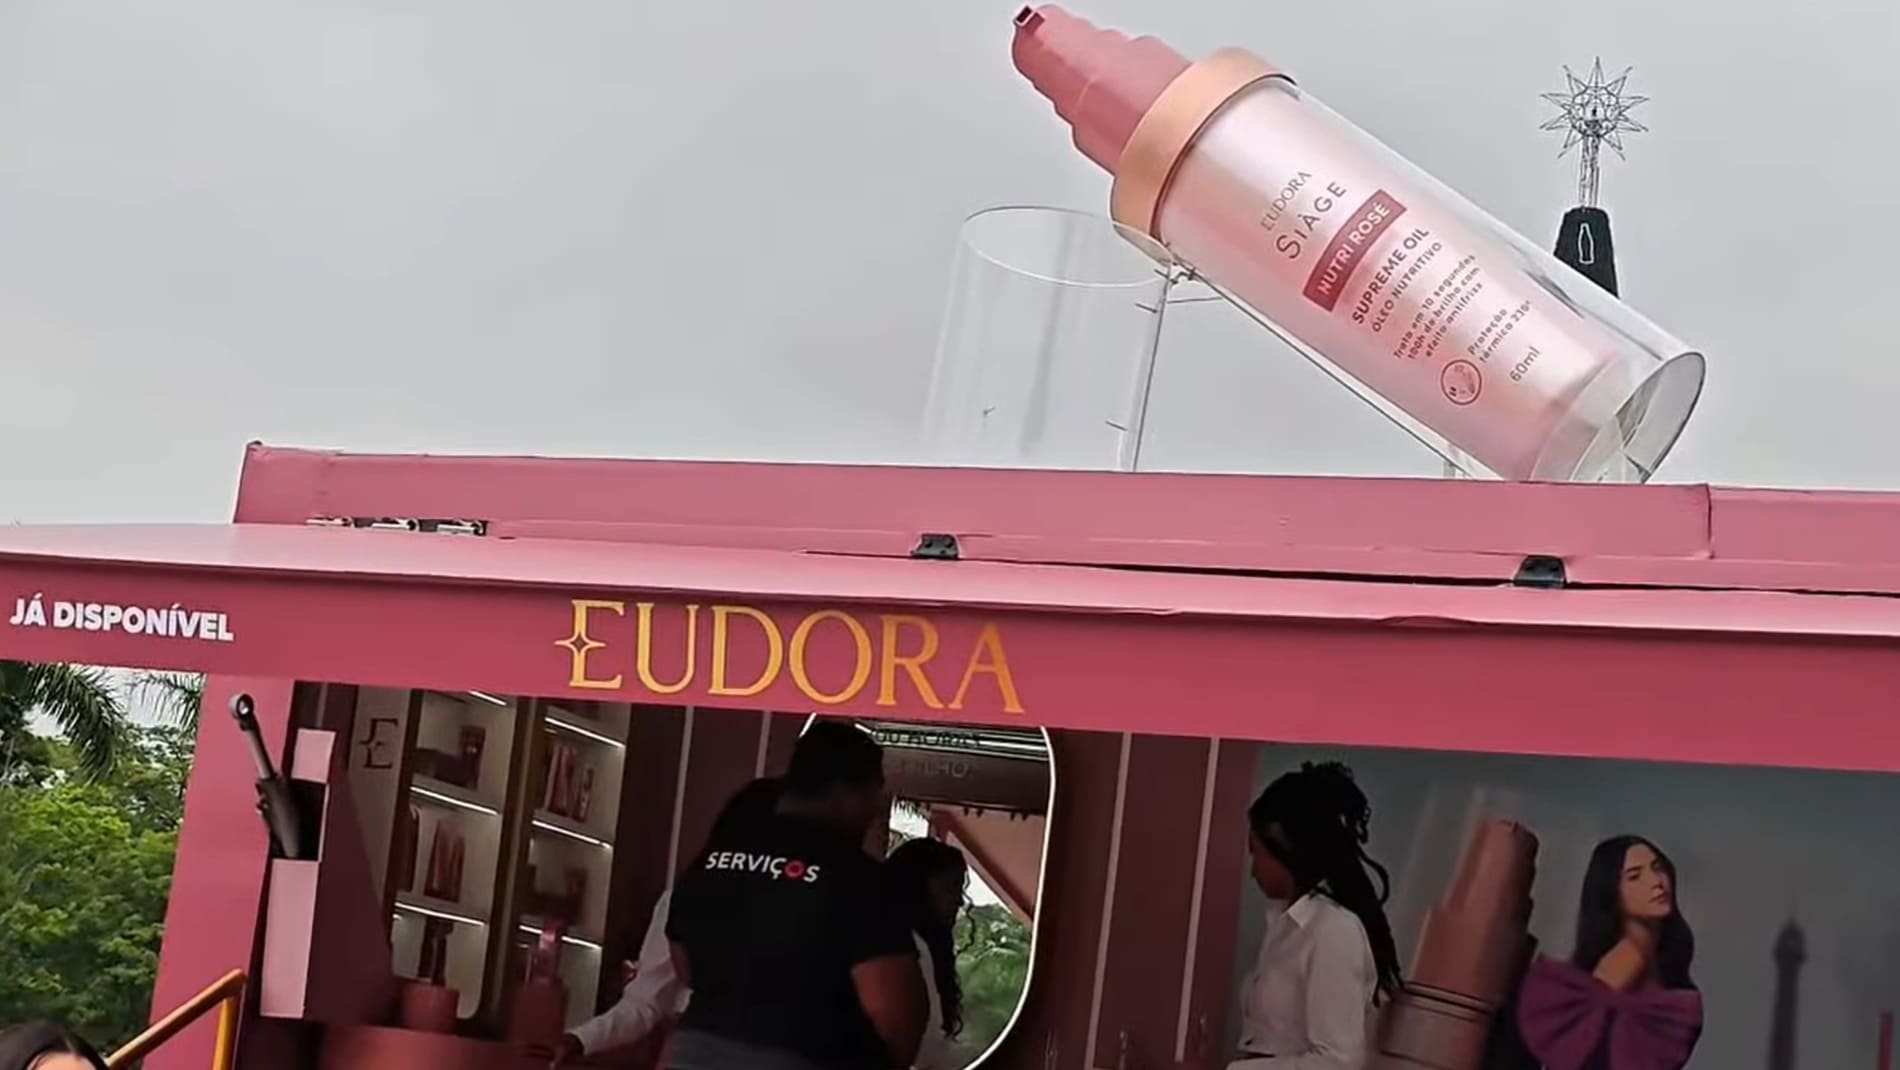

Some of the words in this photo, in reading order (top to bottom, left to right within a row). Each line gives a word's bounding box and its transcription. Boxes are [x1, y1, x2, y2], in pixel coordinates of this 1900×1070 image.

[1260, 171, 1312, 231] EUDORA
[1317, 243, 1354, 295] NUTRI
[1349, 201, 1391, 245] ROSÉ
[1352, 249, 1407, 324] SUPREME
[1403, 228, 1430, 250] OIL
[1391, 242, 1442, 299] NUTRITIVO
[1393, 331, 1413, 358] Trata
[1411, 312, 1425, 329] em
[1421, 297, 1434, 310] 10
[1433, 254, 1476, 297] segundos
[1432, 286, 1461, 318] brilho
[1461, 267, 1480, 287] com
[1425, 325, 1447, 357] efeito
[1509, 345, 1541, 382] 60ml
[9, 593, 47, 626] JÁ
[53, 602, 234, 641] DISPONÍVEL
[555, 600, 1025, 713] EUDORA
[705, 851, 820, 882] SERVIÇOS
